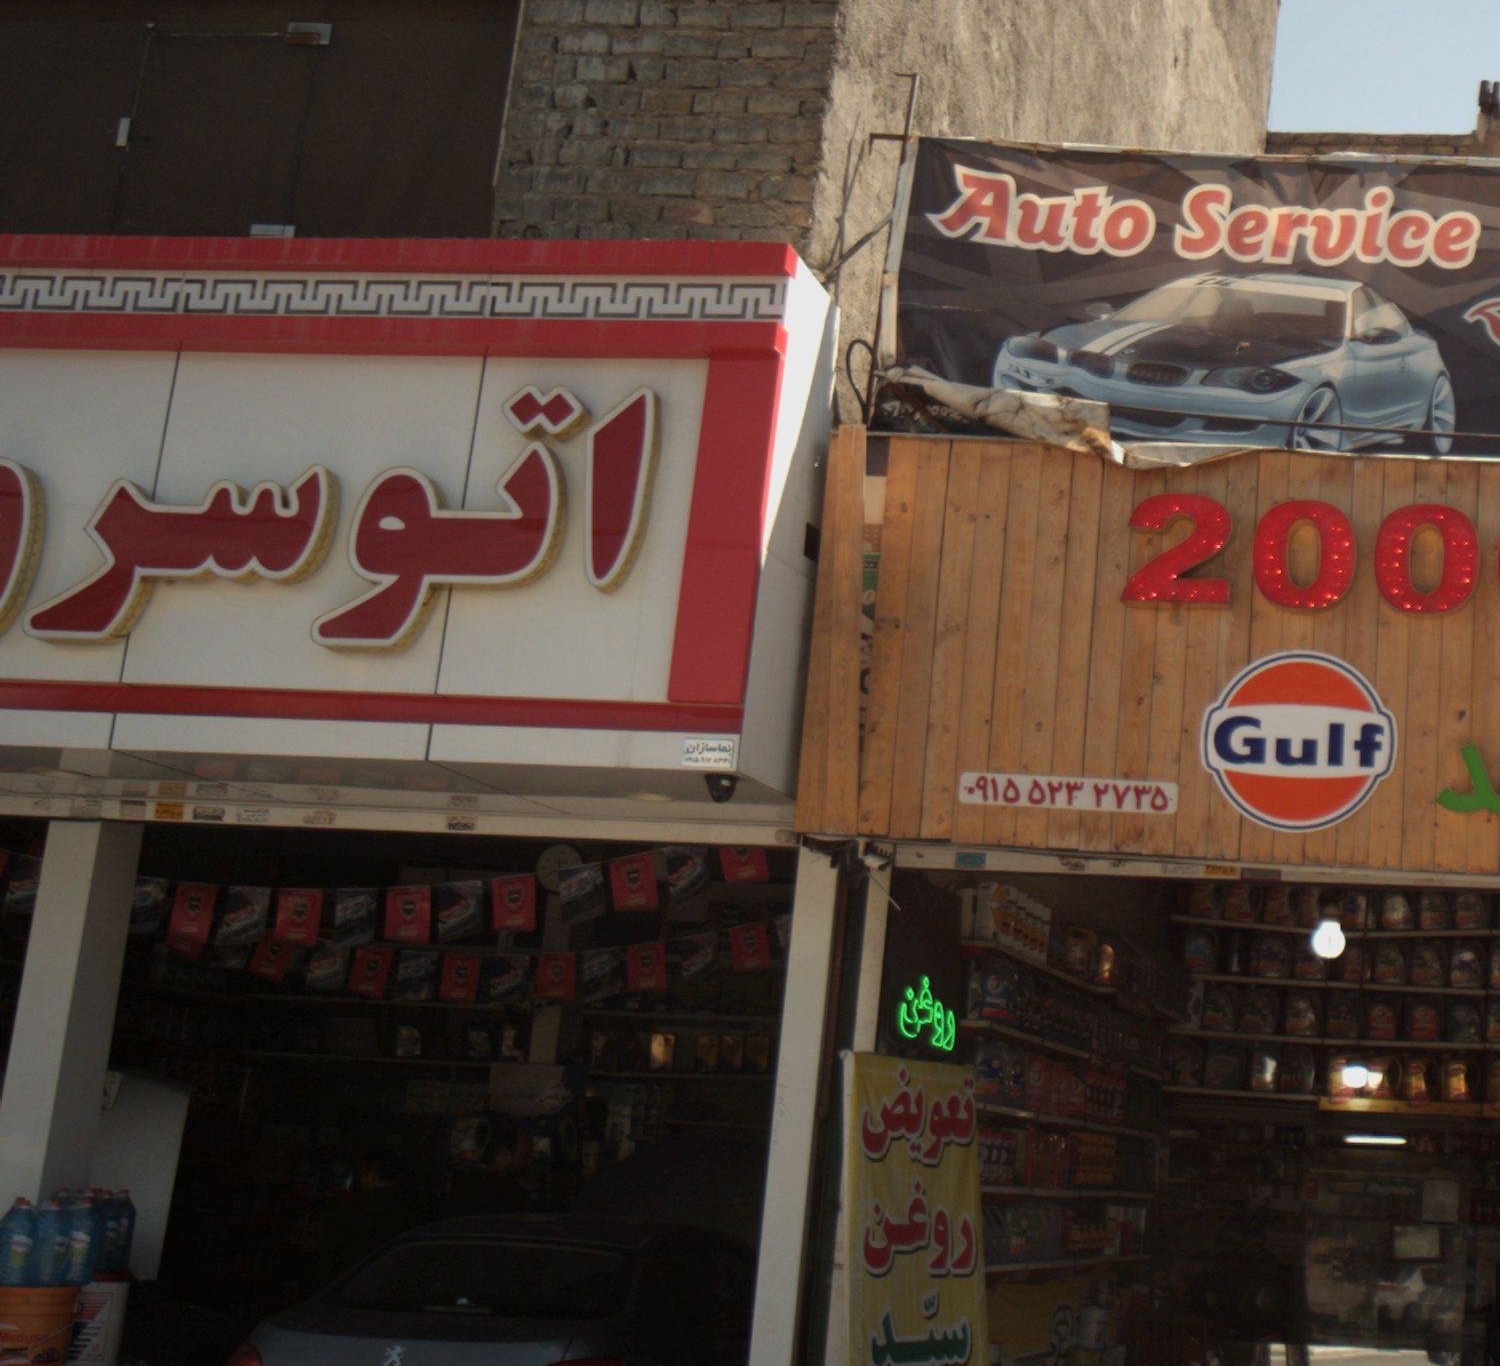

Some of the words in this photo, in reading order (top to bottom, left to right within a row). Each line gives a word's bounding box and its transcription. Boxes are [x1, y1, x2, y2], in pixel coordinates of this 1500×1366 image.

[927, 165, 1156, 257] Auto
[1174, 184, 1482, 269] Service
[1213, 715, 1385, 768] Gulf
[964, 775, 1020, 804] ۰۹۱۵
[1028, 779, 1084, 806] ۵۲۳
[1093, 783, 1168, 811] ۲۷۳۵
[899, 973, 957, 1052] روغن
[860, 1065, 976, 1162] تعویض
[863, 1180, 976, 1277] روغن
